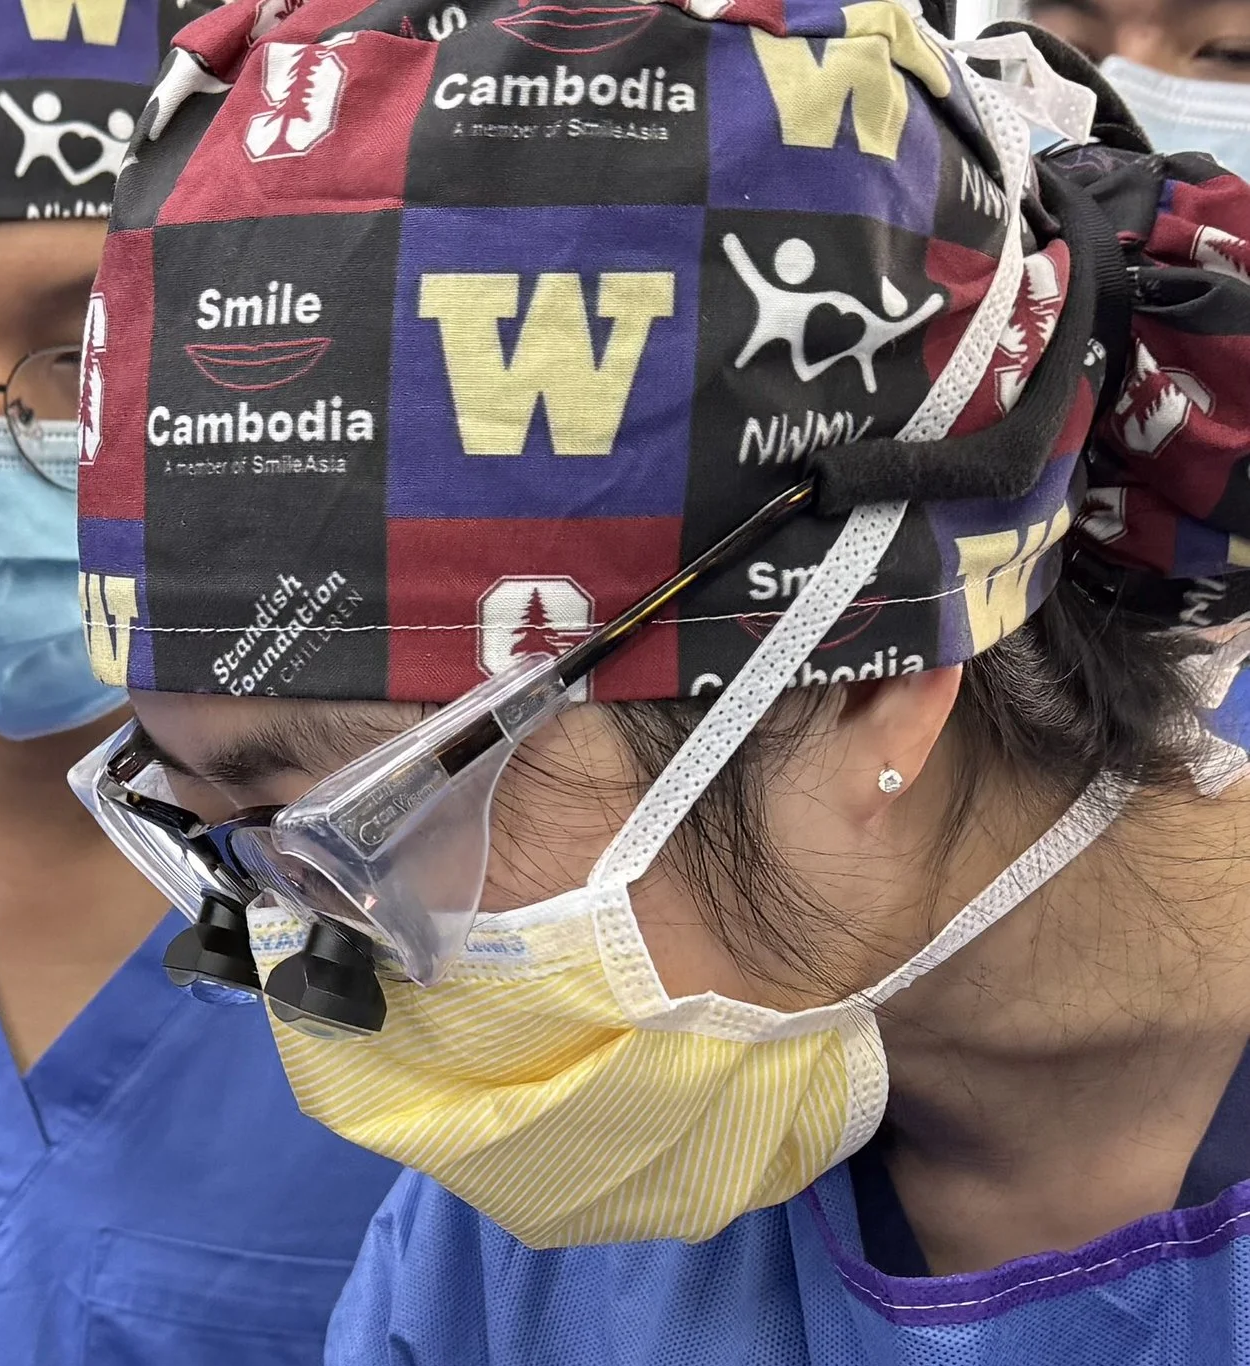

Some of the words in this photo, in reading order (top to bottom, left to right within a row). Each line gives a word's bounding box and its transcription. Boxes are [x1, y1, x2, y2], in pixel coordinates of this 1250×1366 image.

[434, 65, 696, 113] Cambodia
[196, 280, 322, 329] Smile
[419, 272, 675, 455] W
[147, 395, 374, 446] Cambodia
[213, 573, 302, 684] Standish
